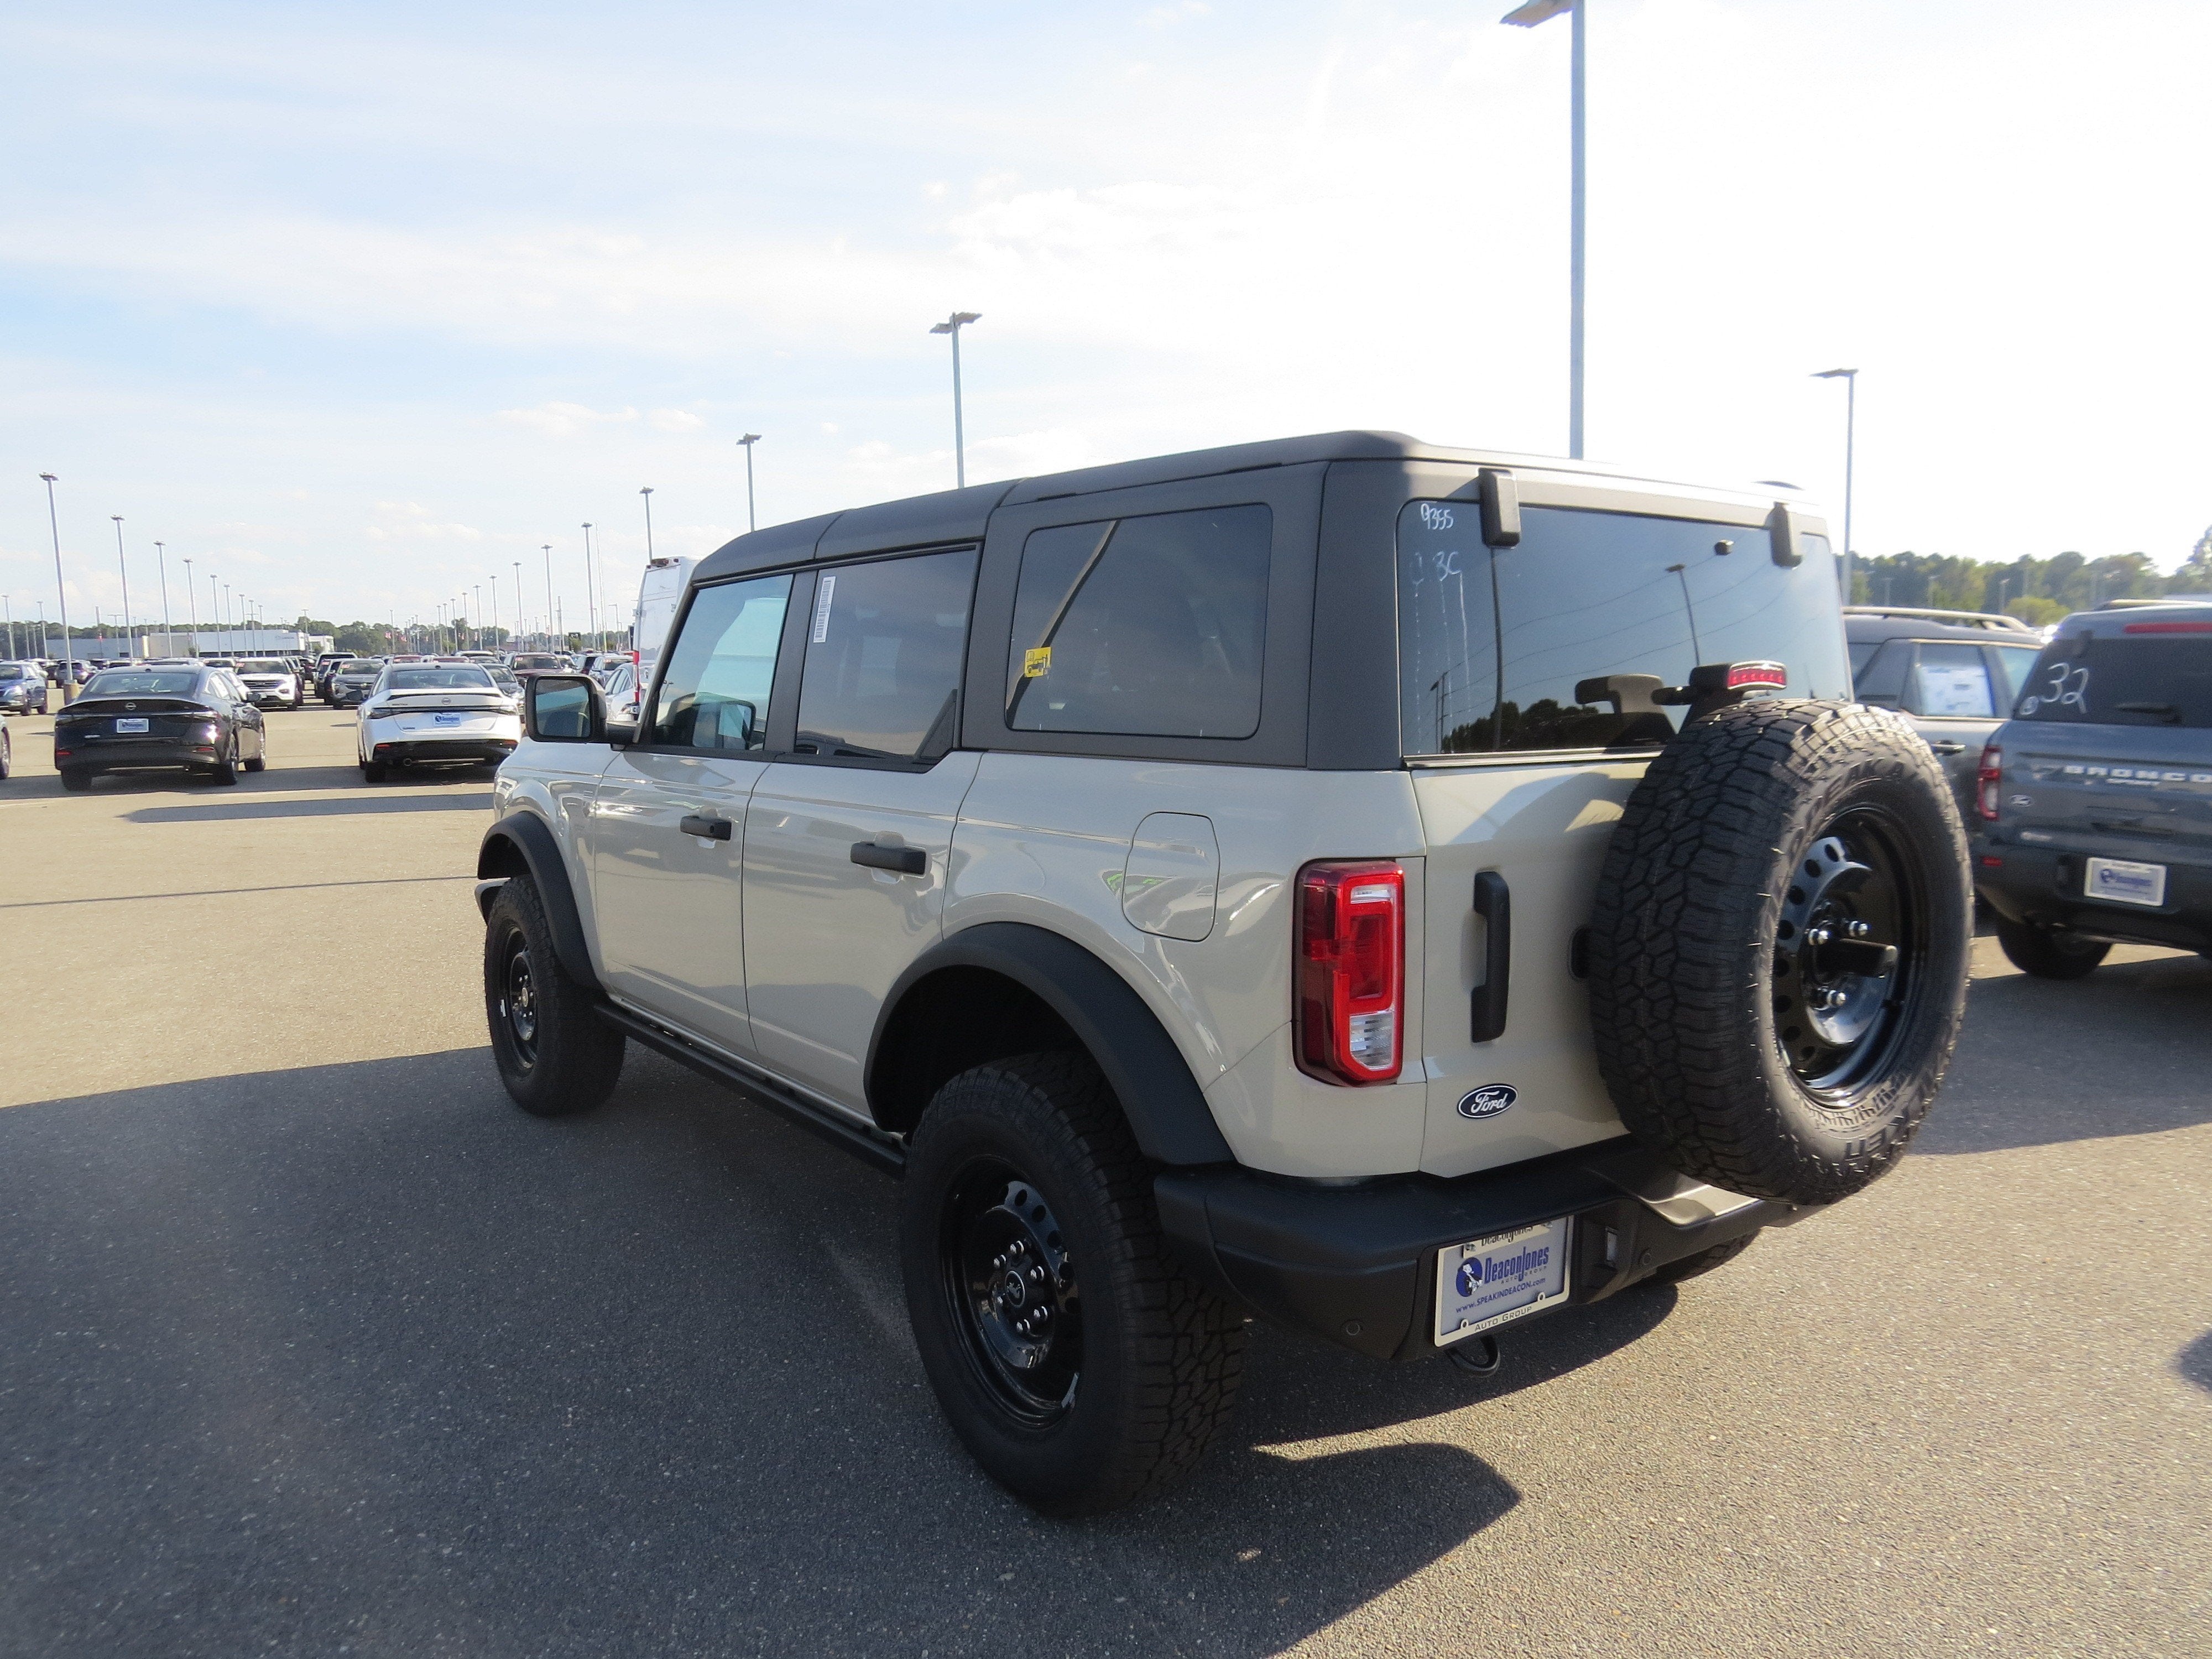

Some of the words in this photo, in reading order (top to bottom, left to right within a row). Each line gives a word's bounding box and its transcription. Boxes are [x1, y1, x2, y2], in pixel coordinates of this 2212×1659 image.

[2039, 662, 2089, 714] 32
[1470, 1090, 1509, 1114] Ford
[1500, 1275, 1518, 1284] AUTO
[1524, 1265, 1547, 1277] GROUP
[1455, 1277, 1546, 1313] www.SPEAKINDEACON.com
[1474, 1318, 1499, 1332] AUTO
[1501, 1306, 1532, 1322] GROUP
